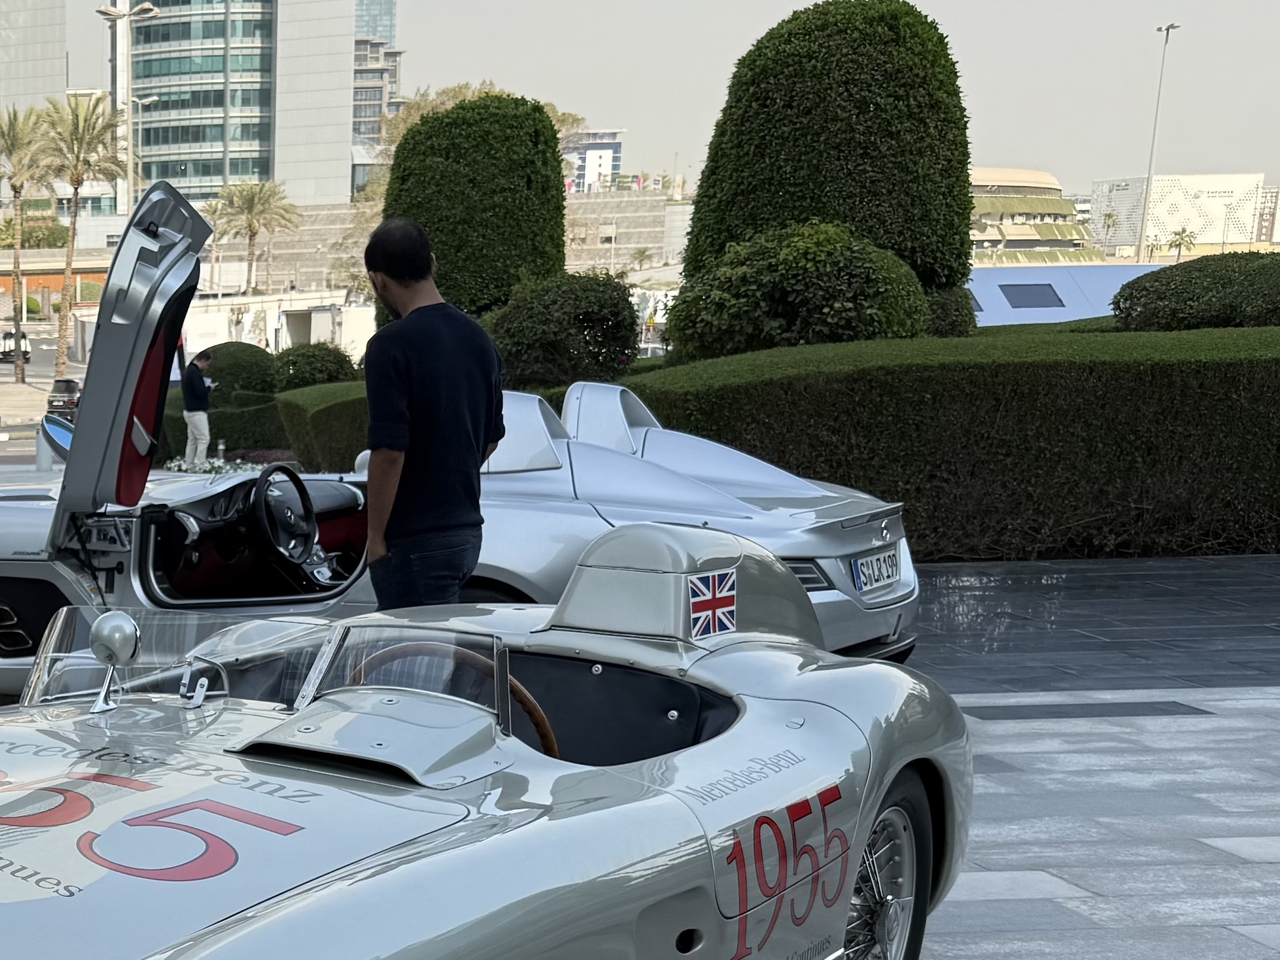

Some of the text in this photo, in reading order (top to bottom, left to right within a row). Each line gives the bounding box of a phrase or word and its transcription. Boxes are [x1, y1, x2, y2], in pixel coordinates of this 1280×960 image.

[860, 553, 898, 587] S LR 199
[677, 749, 806, 806] Mercedes-Benz
